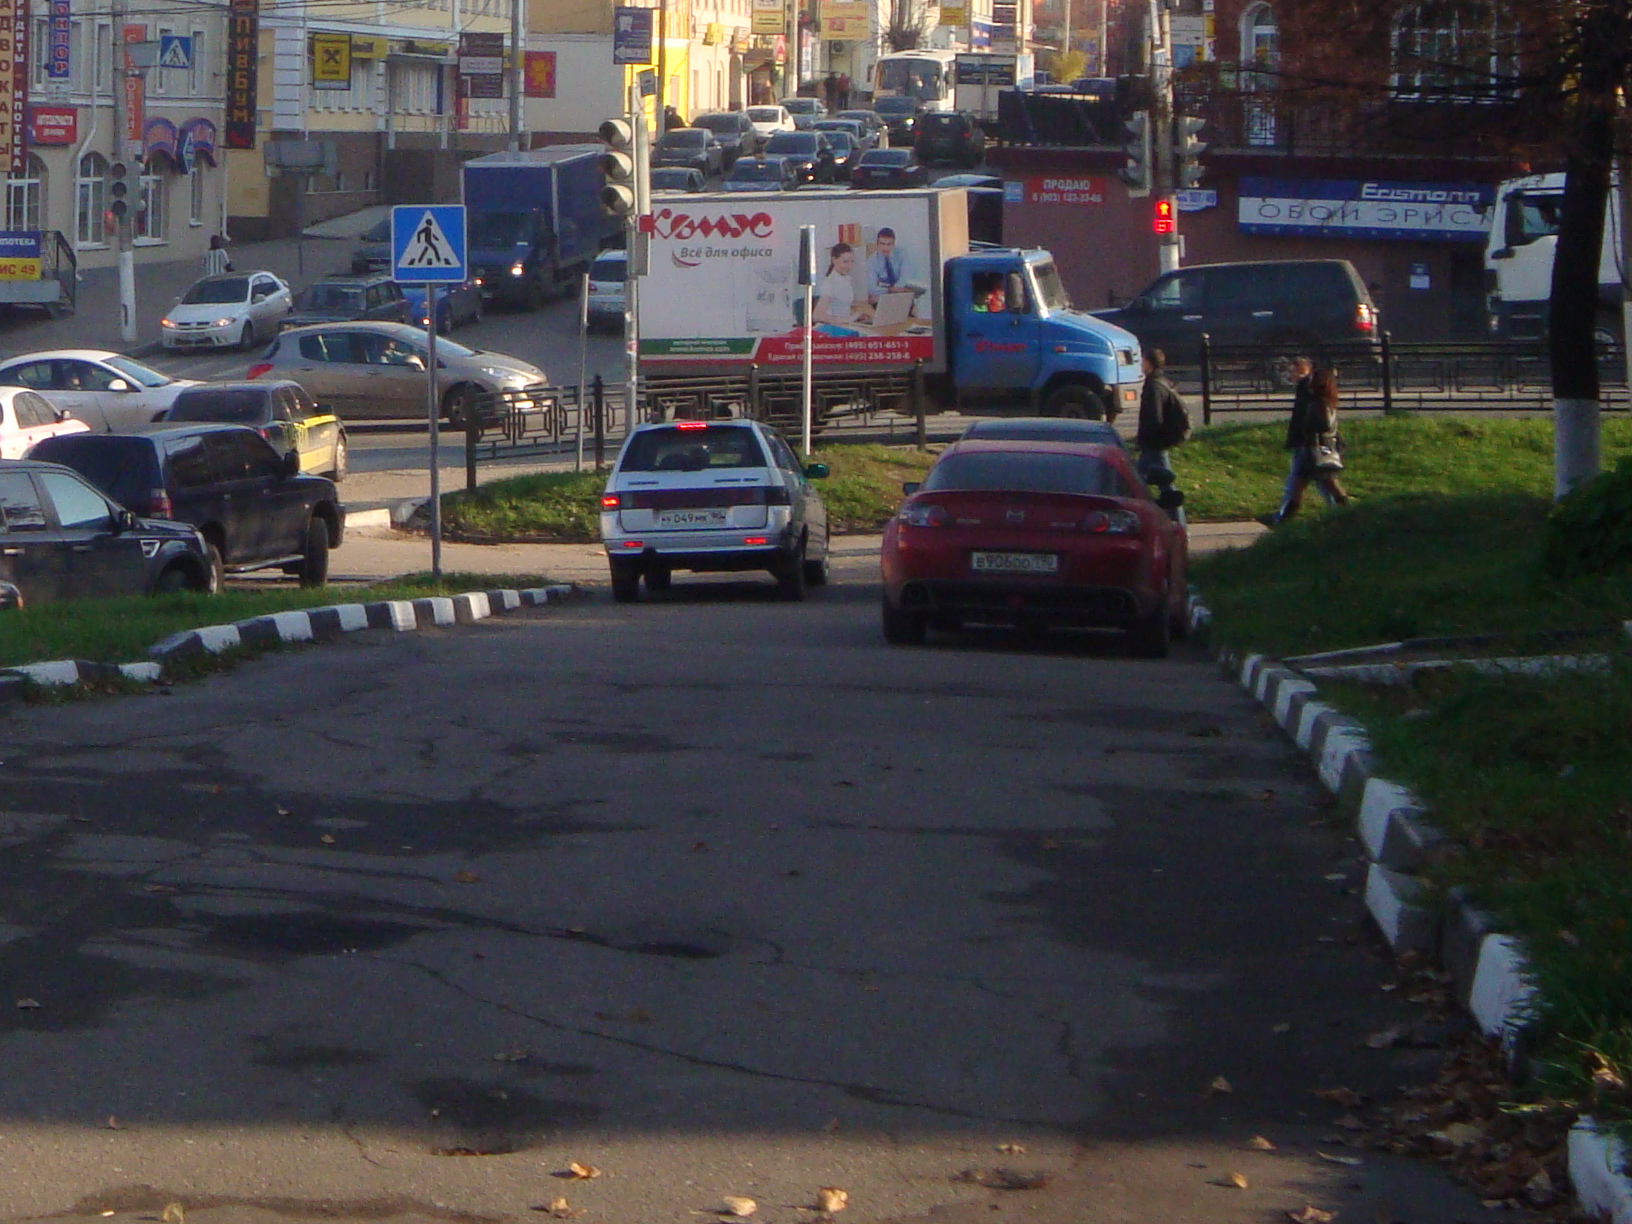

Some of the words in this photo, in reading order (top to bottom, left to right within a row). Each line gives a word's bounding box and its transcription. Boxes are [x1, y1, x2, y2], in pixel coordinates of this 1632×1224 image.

[13, 90, 23, 167] ИПОТЕКА
[1043, 179, 1090, 191] ПРОДАЮ
[1259, 203, 1359, 222] ОБОИ
[680, 247, 702, 258] Всё
[705, 247, 728, 258] для
[731, 247, 772, 259] офиса
[21, 264, 36, 275] 49
